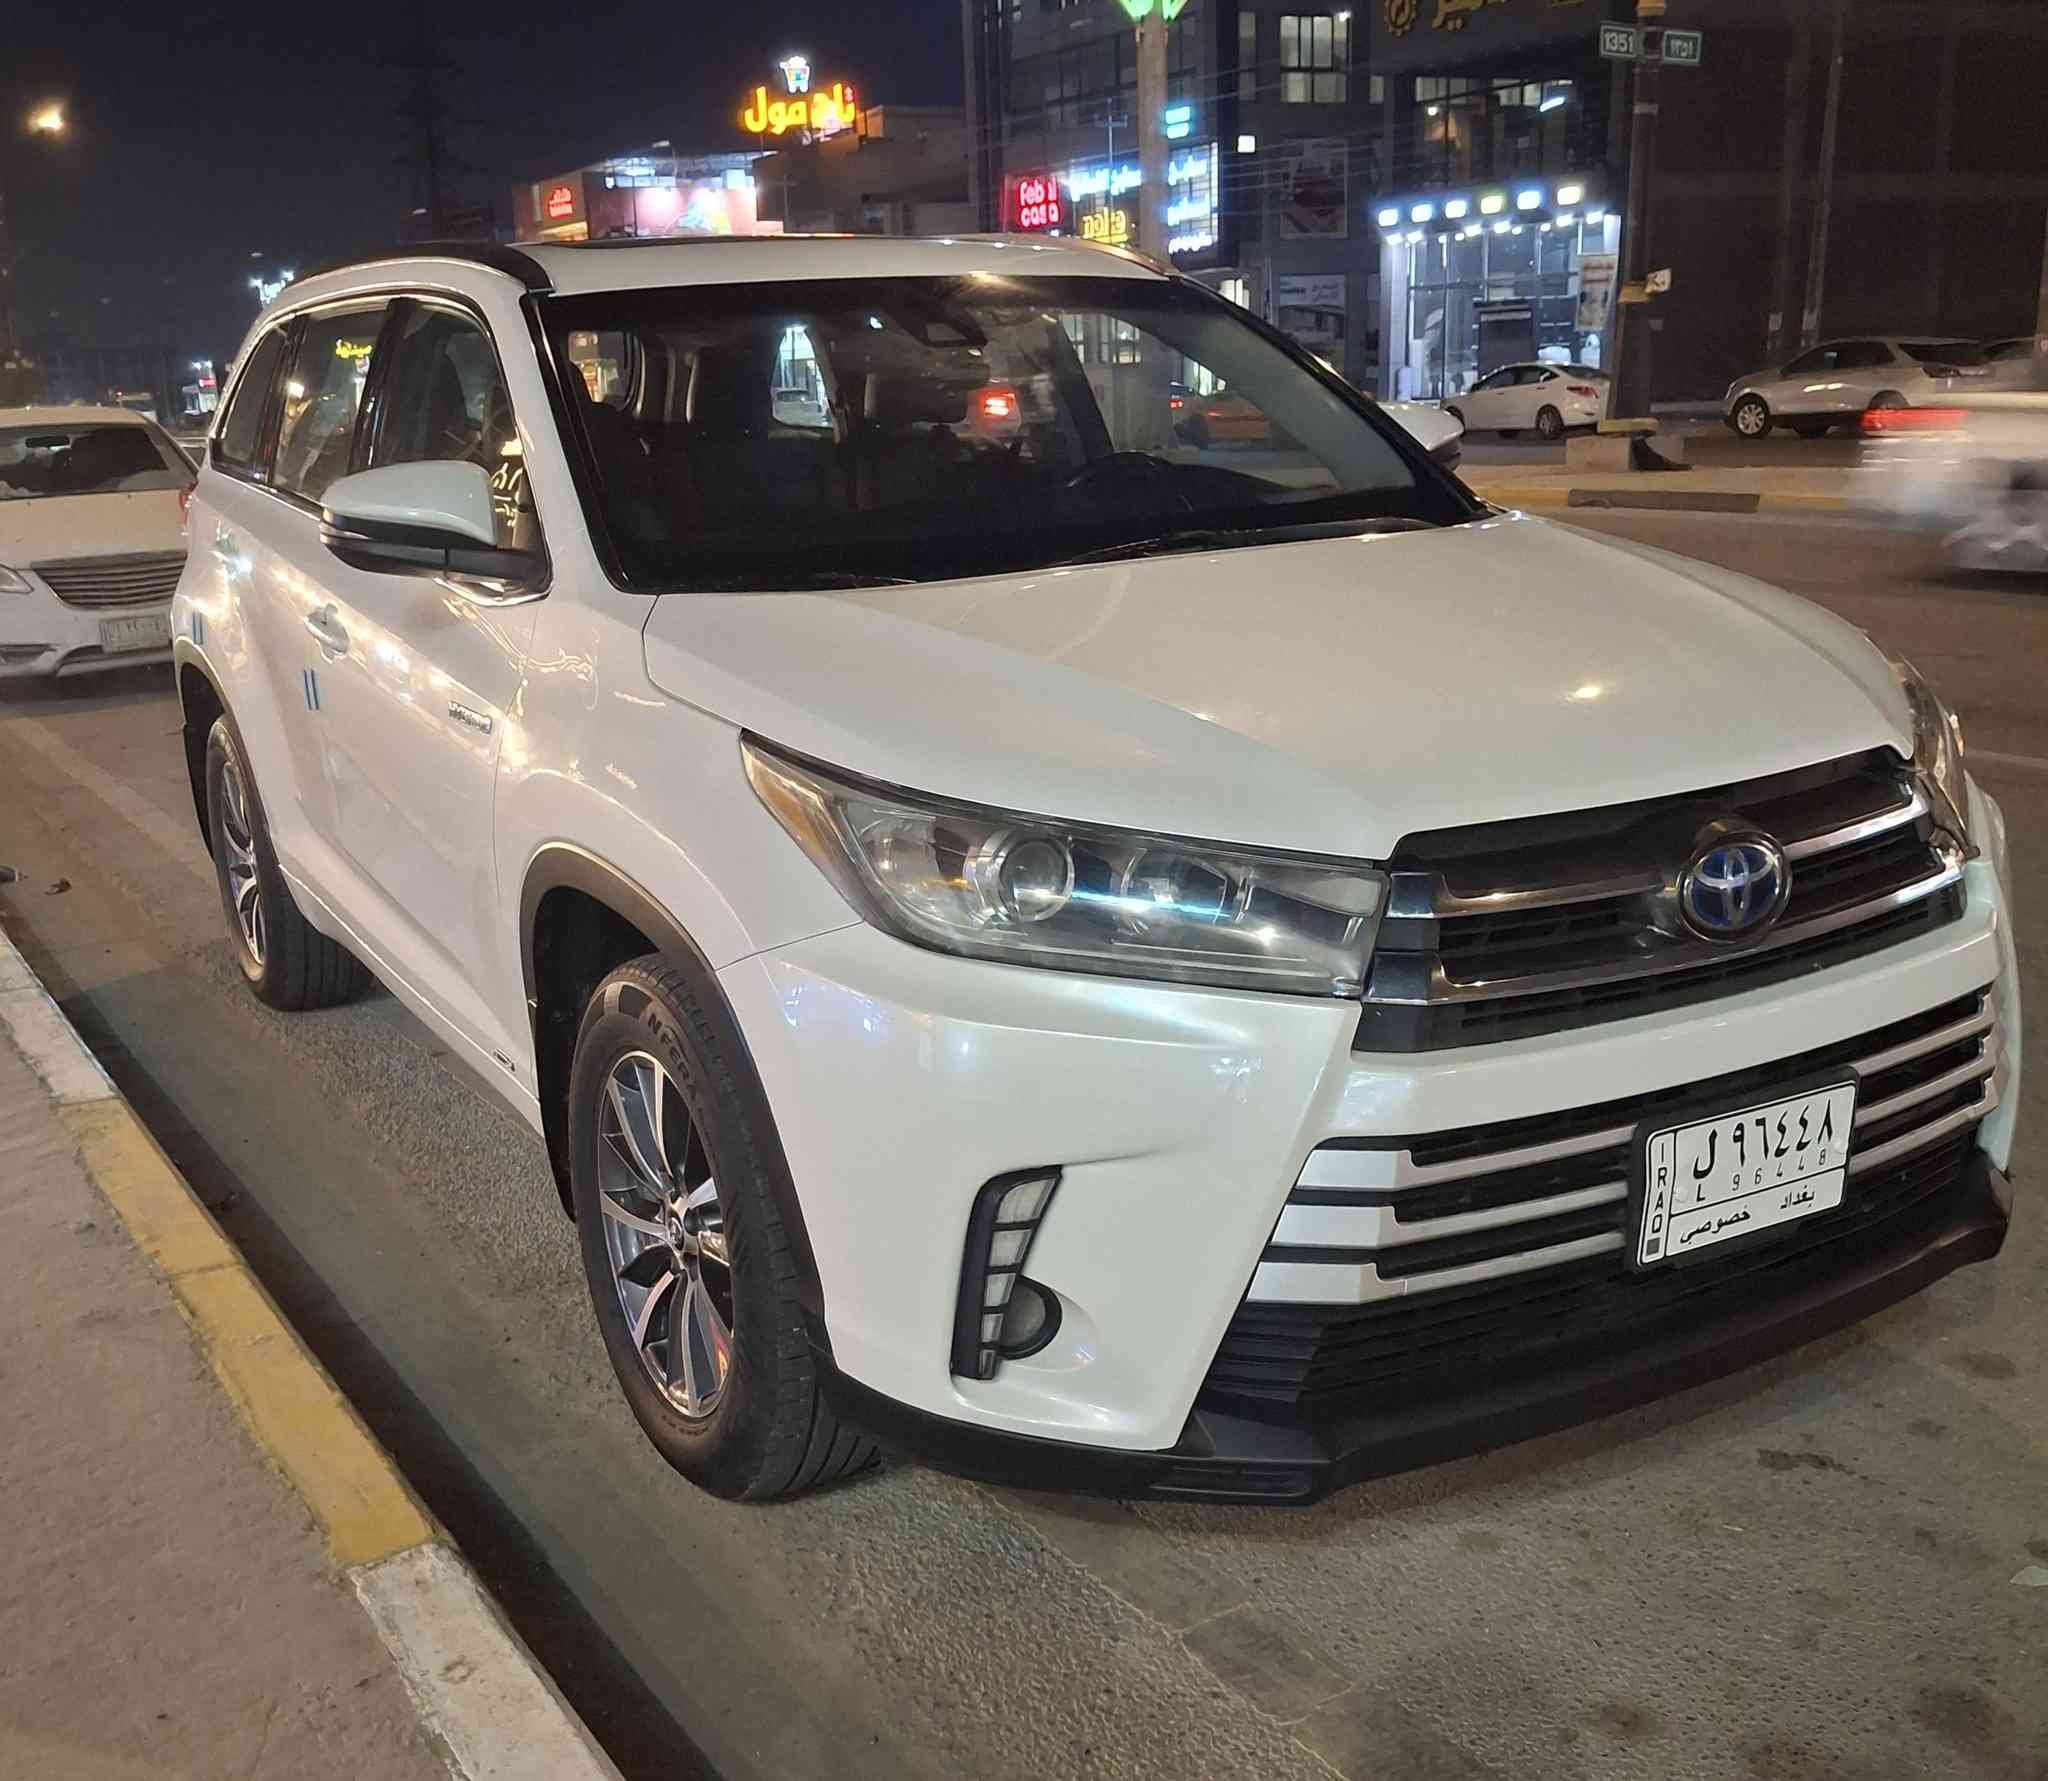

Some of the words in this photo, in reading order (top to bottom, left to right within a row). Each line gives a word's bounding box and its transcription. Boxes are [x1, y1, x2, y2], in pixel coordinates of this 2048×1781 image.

[1603, 31, 1634, 54] 1351
[744, 86, 808, 135] مول
[1693, 1129, 1718, 1180] ل
[1732, 1098, 1833, 1168] ٩٦٤٤٨
[1680, 1203, 1751, 1246] خصوصي
[1780, 1184, 1815, 1209] بغداد
[1696, 1183, 1706, 1202] L
